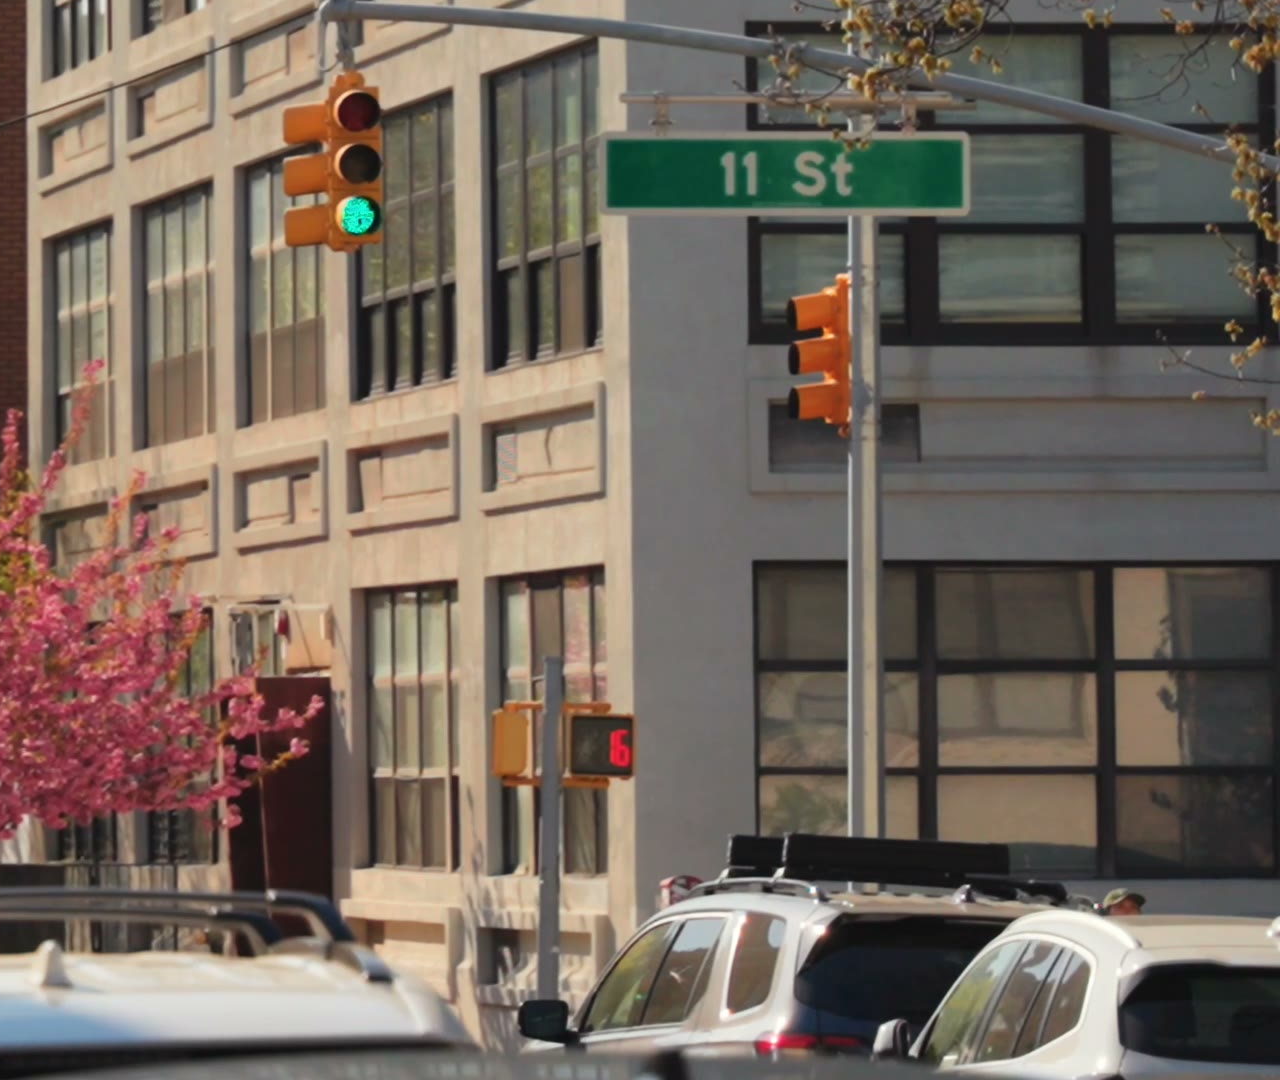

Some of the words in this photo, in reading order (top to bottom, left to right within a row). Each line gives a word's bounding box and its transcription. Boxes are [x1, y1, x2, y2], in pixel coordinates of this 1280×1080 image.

[721, 151, 758, 197] 11
[792, 150, 854, 197] St
[609, 729, 631, 768] 6
